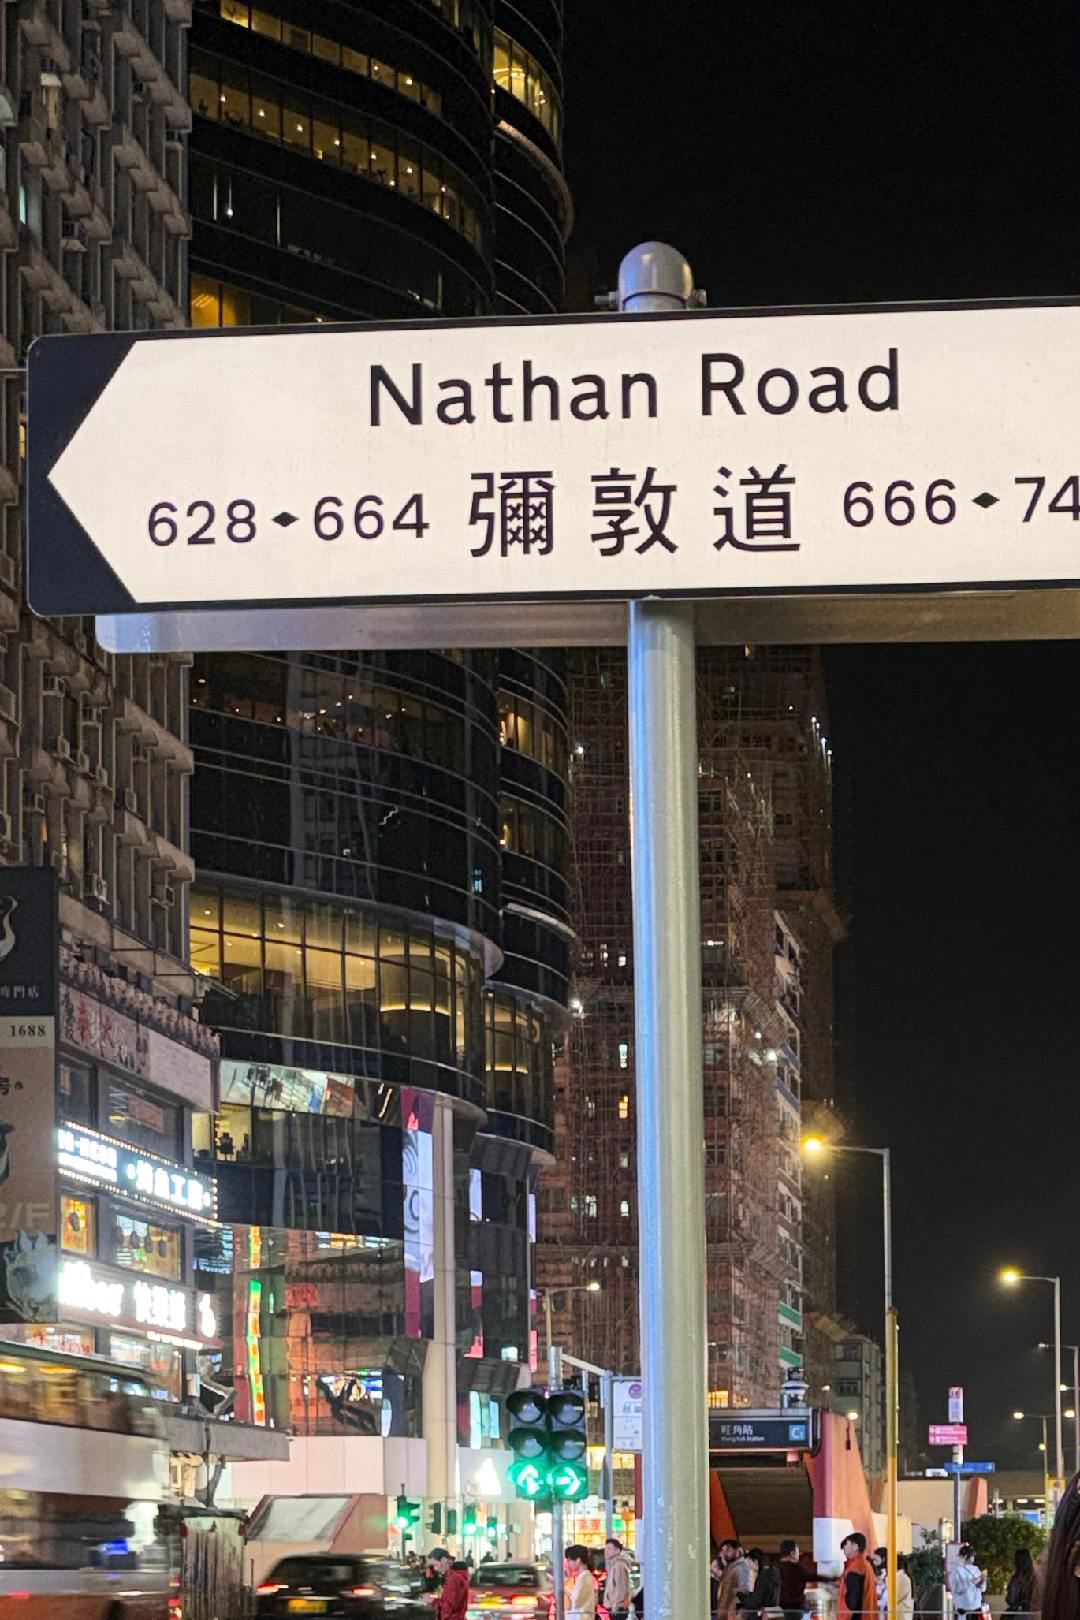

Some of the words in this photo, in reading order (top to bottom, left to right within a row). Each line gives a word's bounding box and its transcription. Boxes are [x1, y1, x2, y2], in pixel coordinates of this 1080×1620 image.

[371, 361, 658, 427] Nathan
[702, 348, 899, 416] Road
[468, 464, 801, 558] 彌敦道
[10, 1024, 46, 1037] 1688
